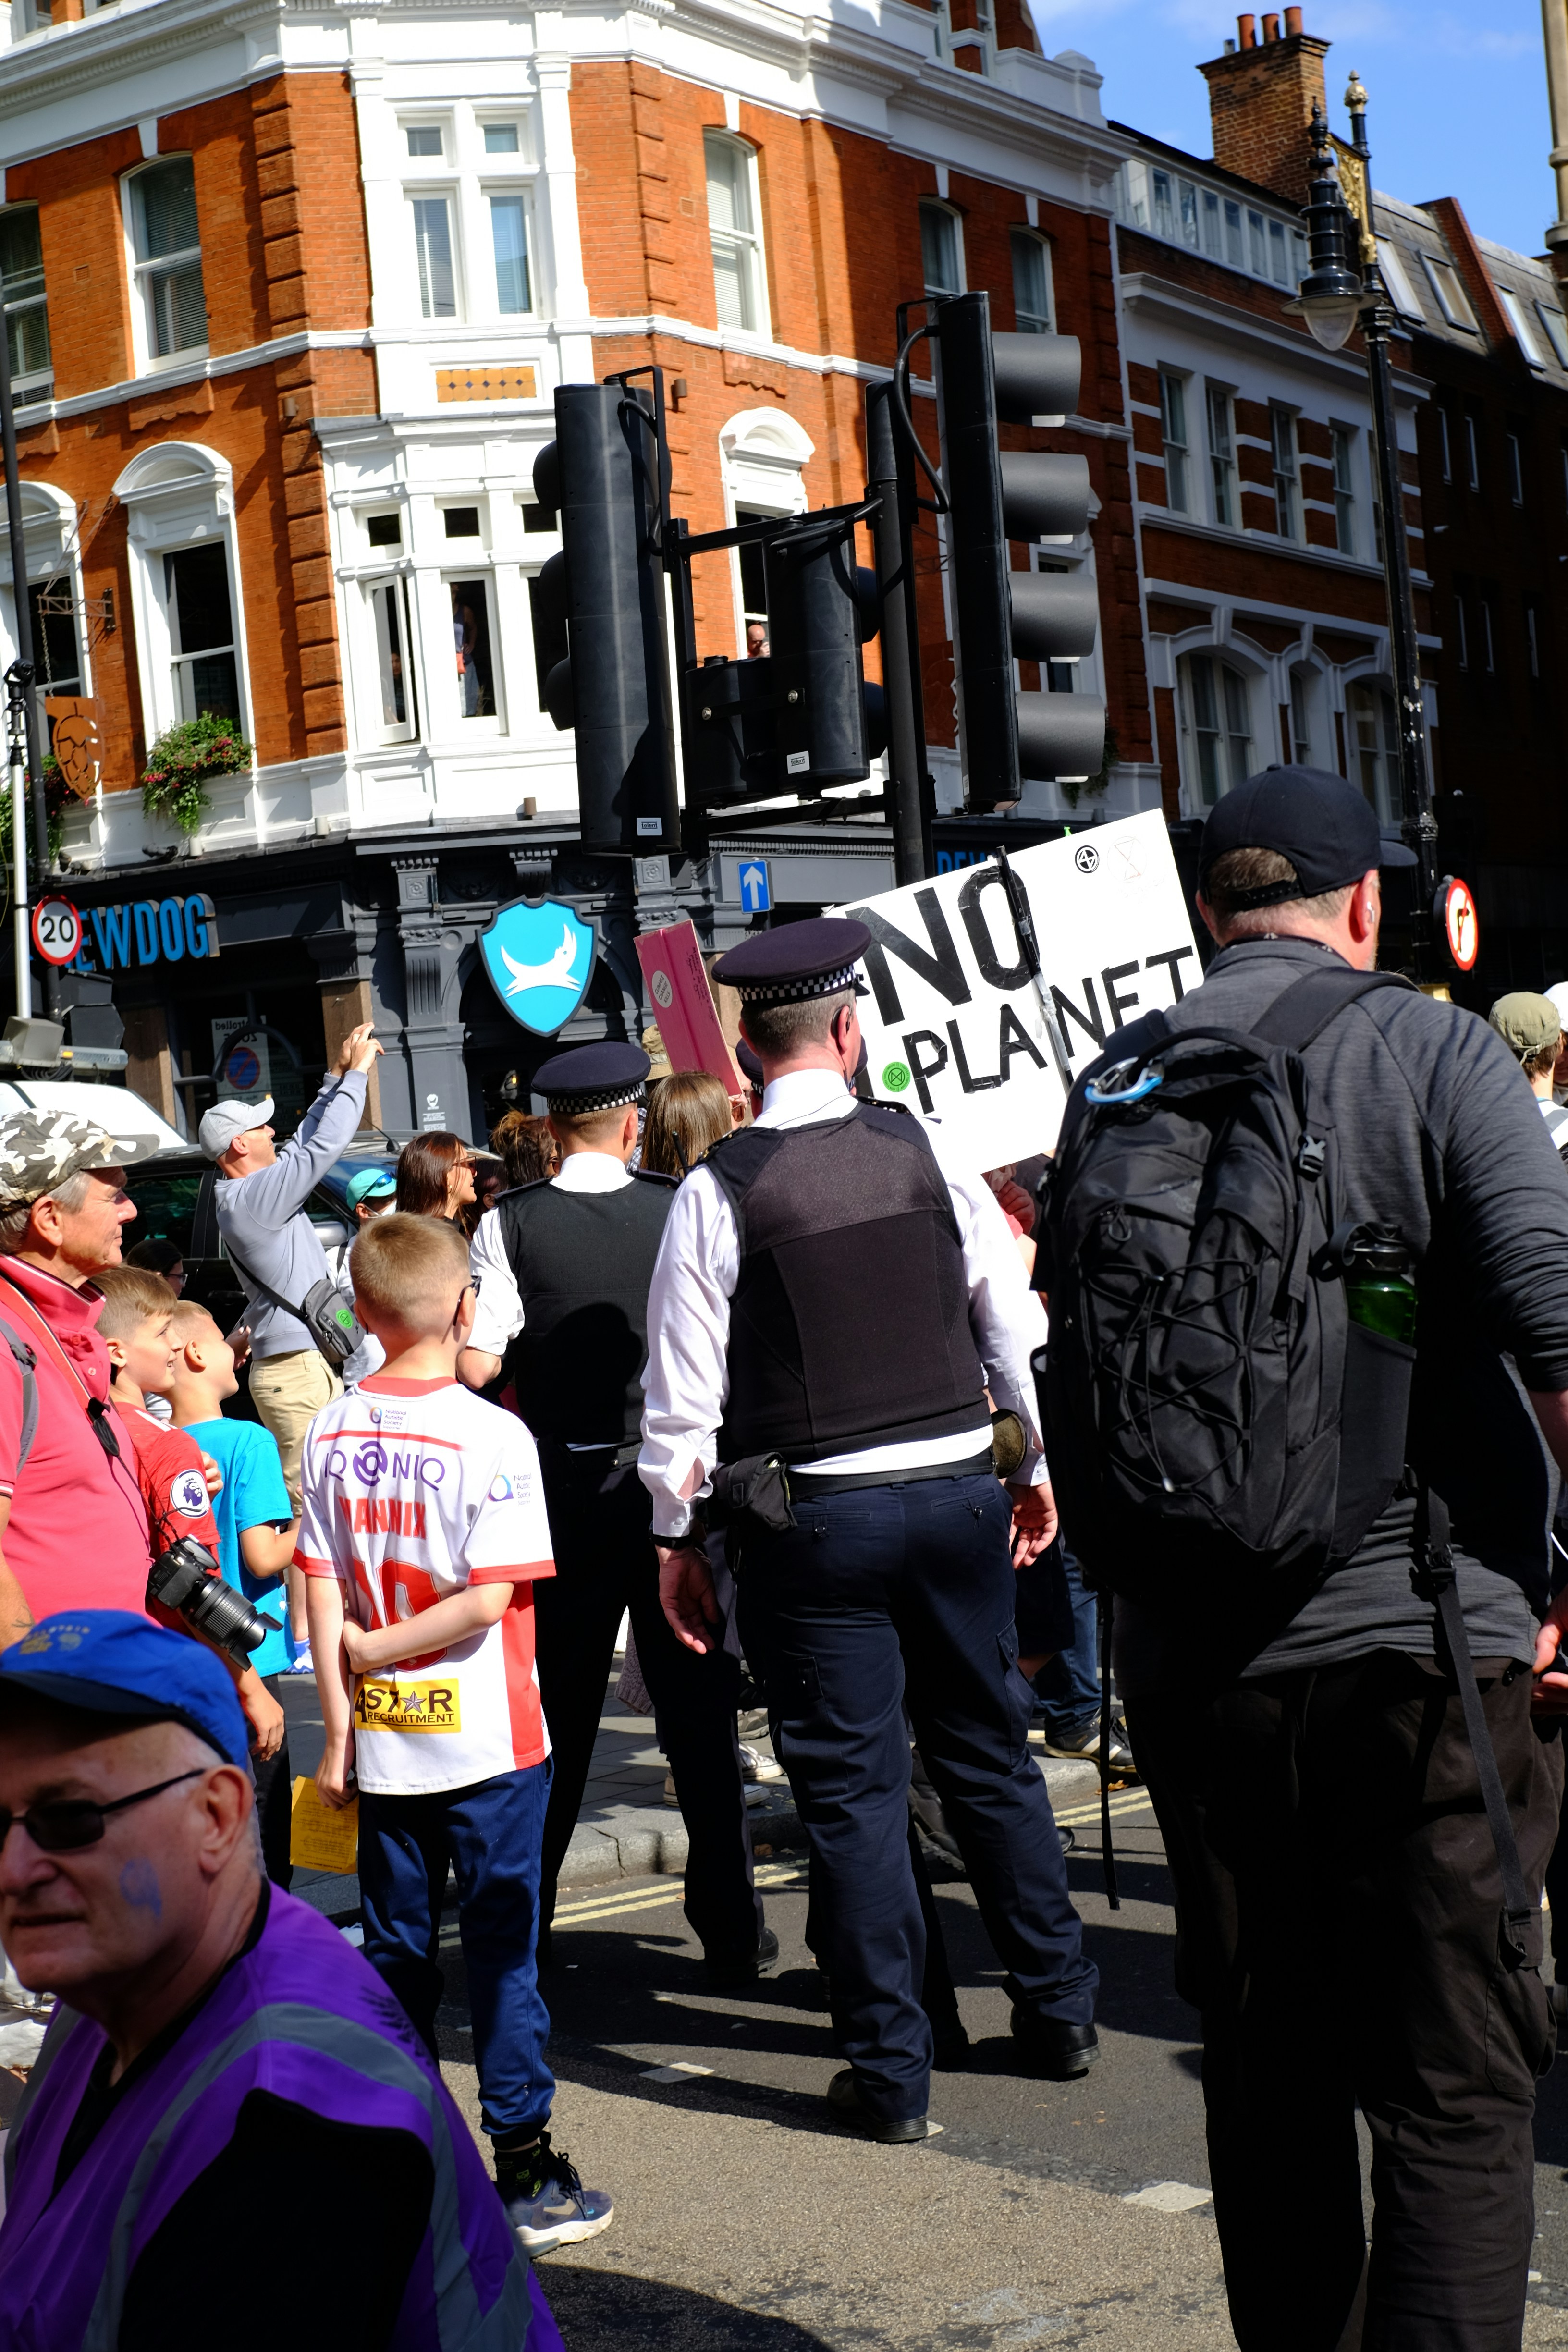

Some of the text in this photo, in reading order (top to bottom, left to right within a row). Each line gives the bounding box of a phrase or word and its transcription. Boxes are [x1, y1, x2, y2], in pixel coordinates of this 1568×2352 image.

[41, 915, 75, 943] 20
[65, 893, 220, 971] EWDOG
[845, 865, 1041, 1027] NO
[655, 974, 664, 995] CLIMATE
[659, 981, 668, 1001] CHANGE
[368, 1712, 455, 1723] RECRUITMENT
